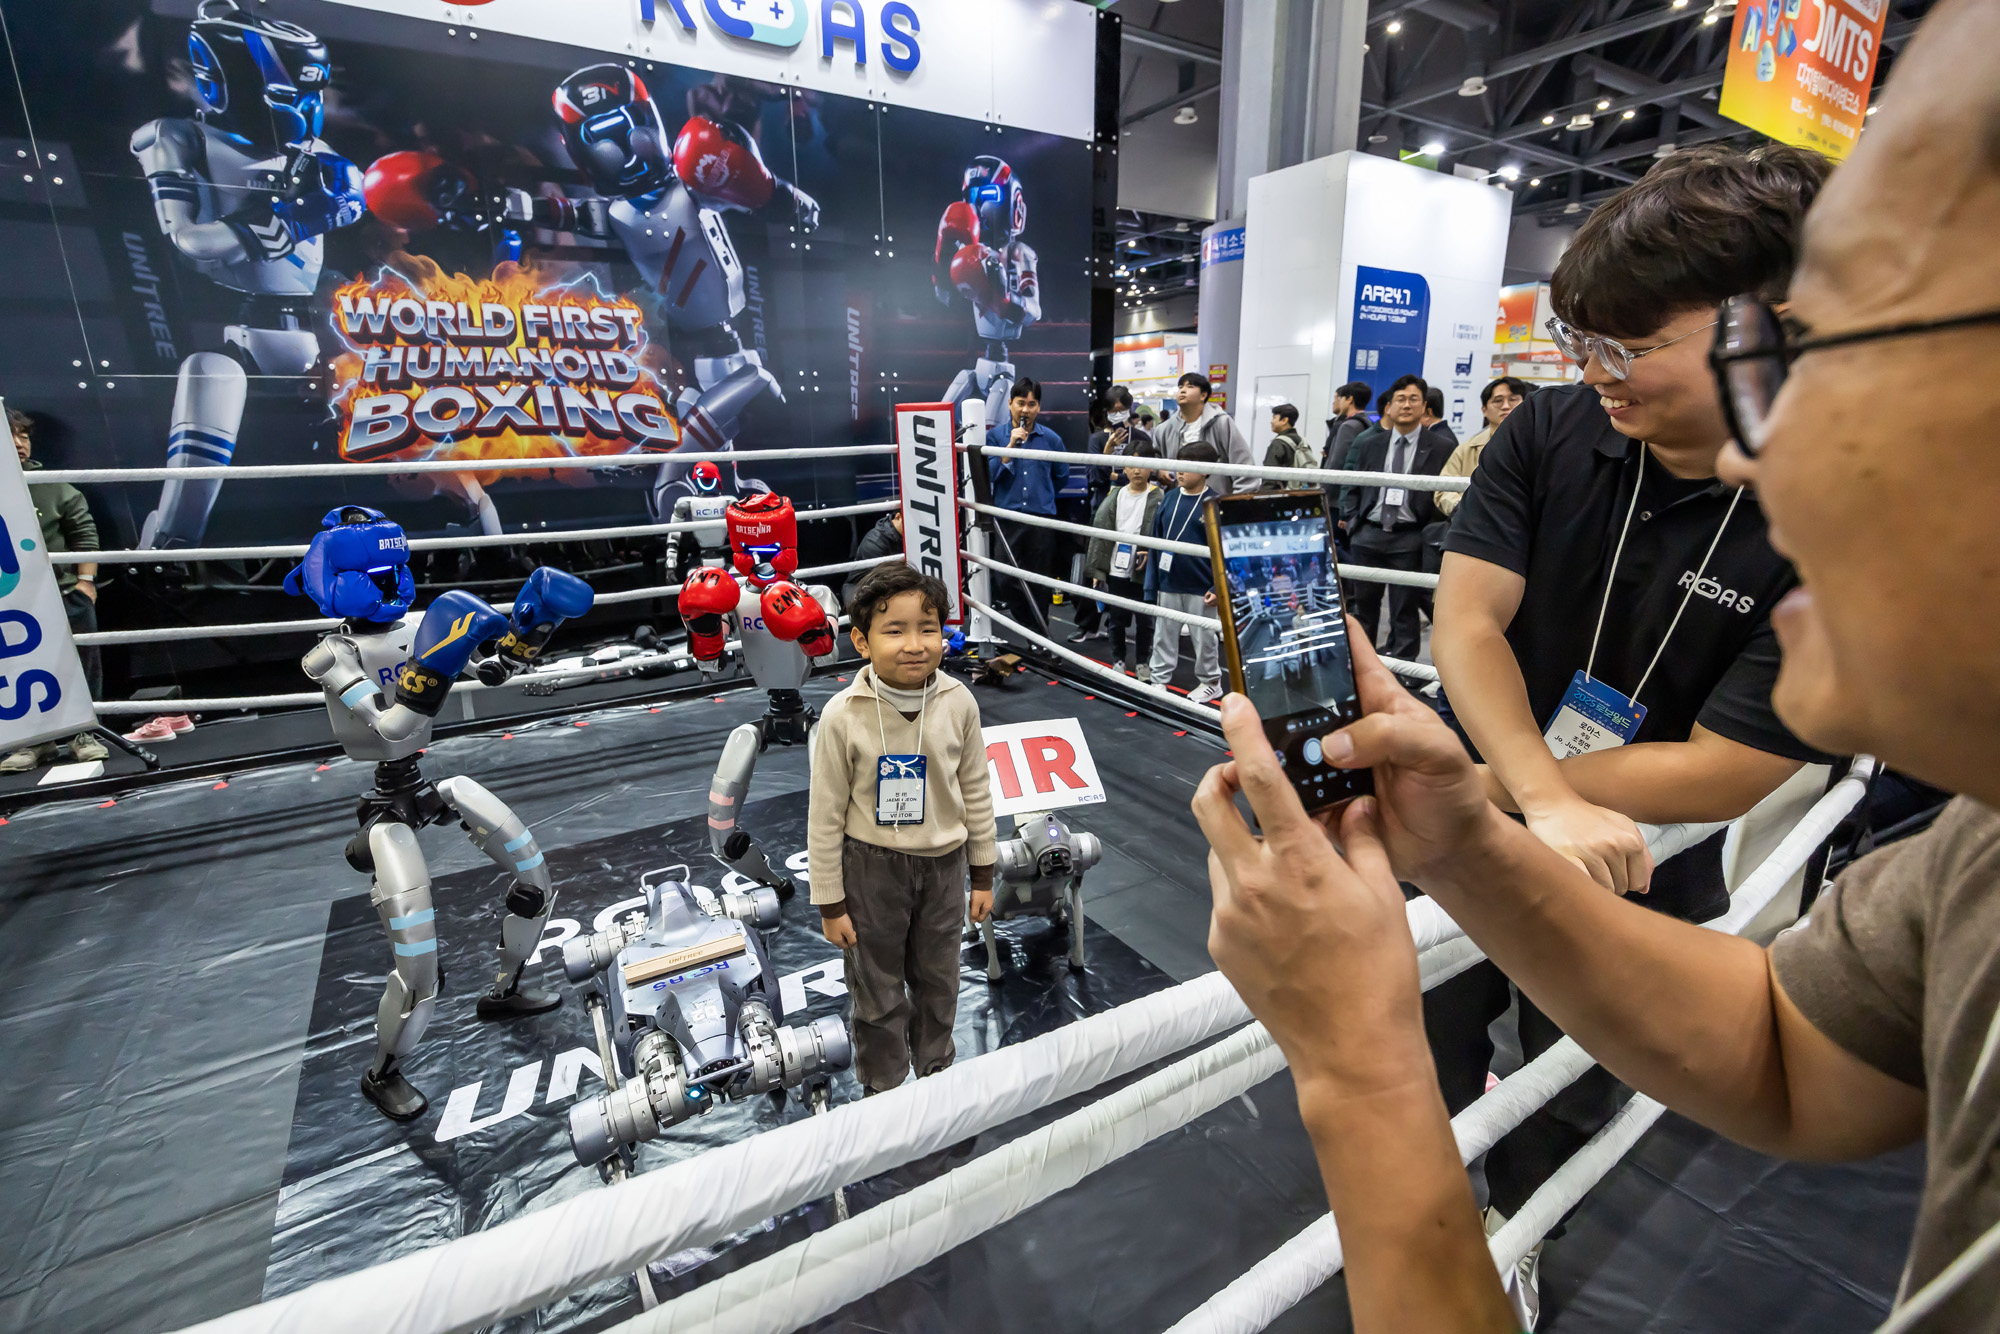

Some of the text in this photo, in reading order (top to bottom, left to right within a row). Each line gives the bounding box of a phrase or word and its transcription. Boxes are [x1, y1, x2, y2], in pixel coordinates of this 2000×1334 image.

[120, 231, 178, 360] UNITREE
[340, 296, 642, 343] WORLD FIRST
[363, 346, 640, 385] HUMANOID
[845, 306, 867, 420] UNITREE
[344, 385, 682, 455] BOXING
[910, 414, 947, 584] UNITRE
[1677, 570, 1755, 614] ROAS
[1578, 721, 1601, 739] 로아스
